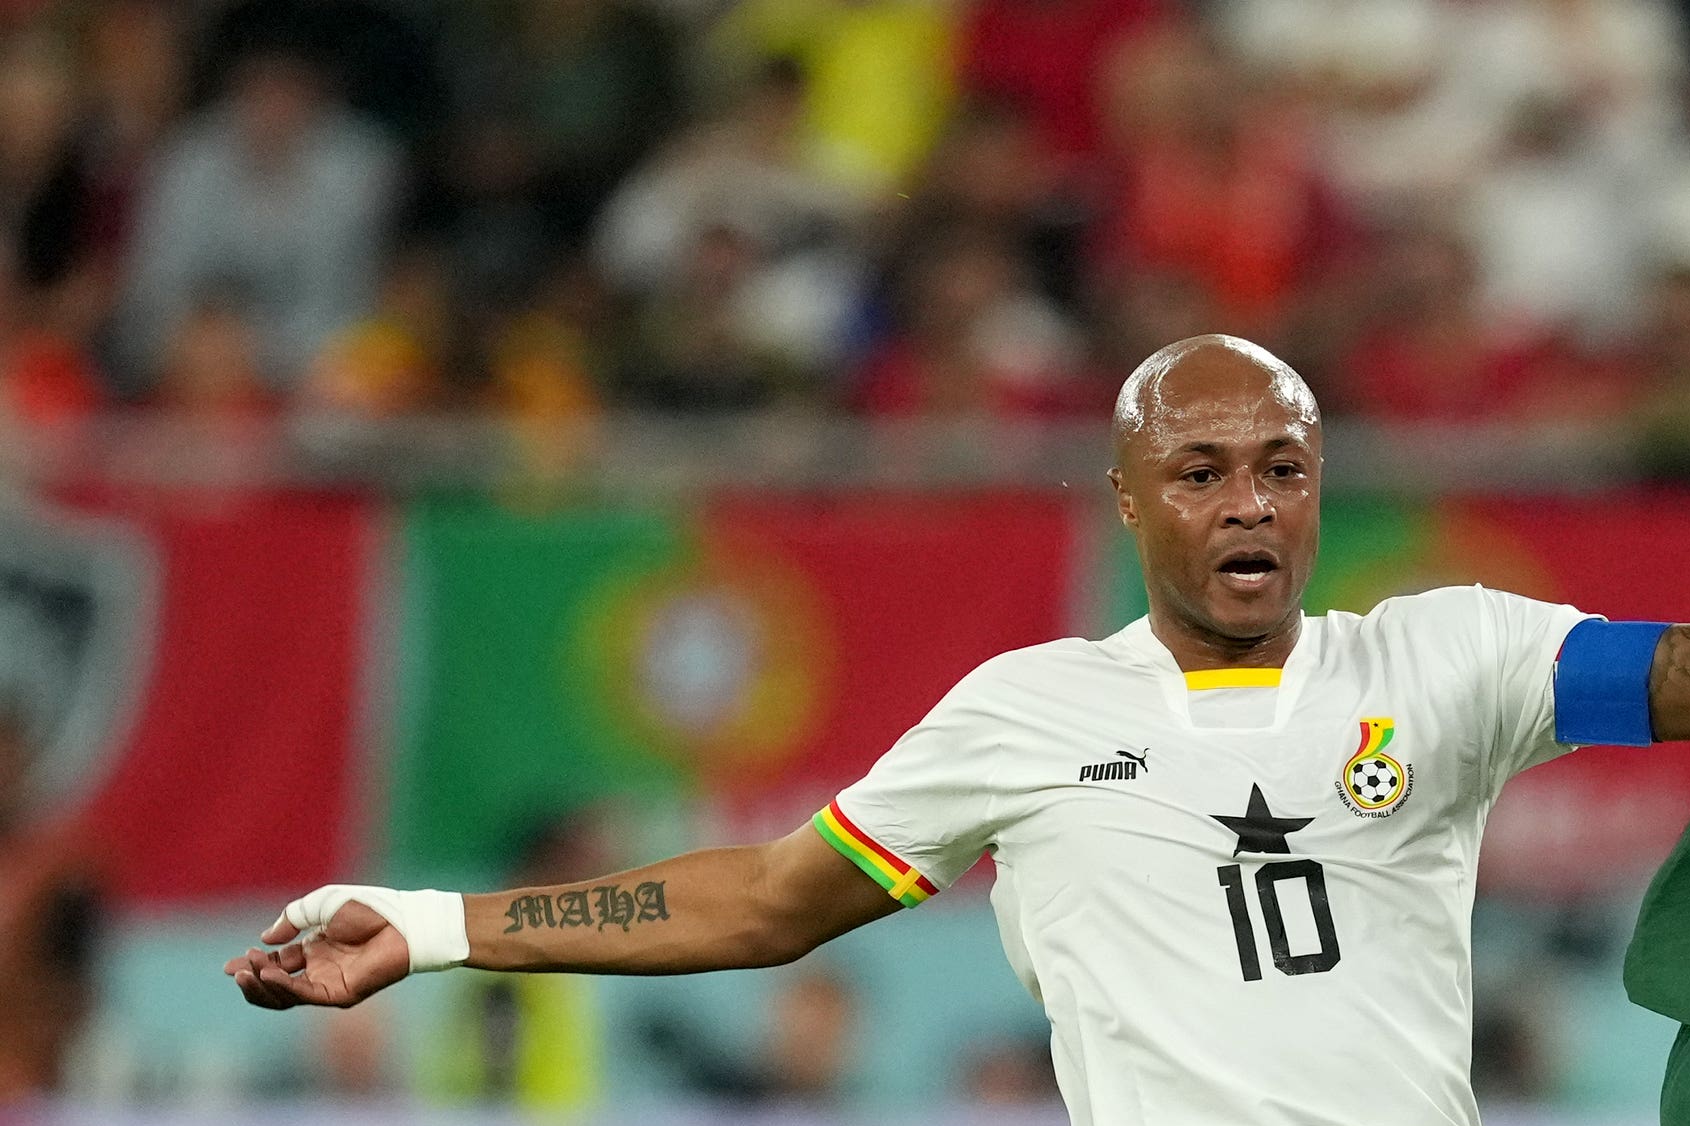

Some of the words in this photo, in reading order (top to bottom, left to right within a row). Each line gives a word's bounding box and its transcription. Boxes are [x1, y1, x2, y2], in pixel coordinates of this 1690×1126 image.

[1079, 761, 1137, 782] PUMA
[1334, 780, 1351, 808] GHANA
[1350, 806, 1392, 819] FOOTBALL
[1391, 763, 1415, 815] ASSOCIATION
[503, 880, 671, 935] MAHA
[1216, 858, 1341, 982] 10
